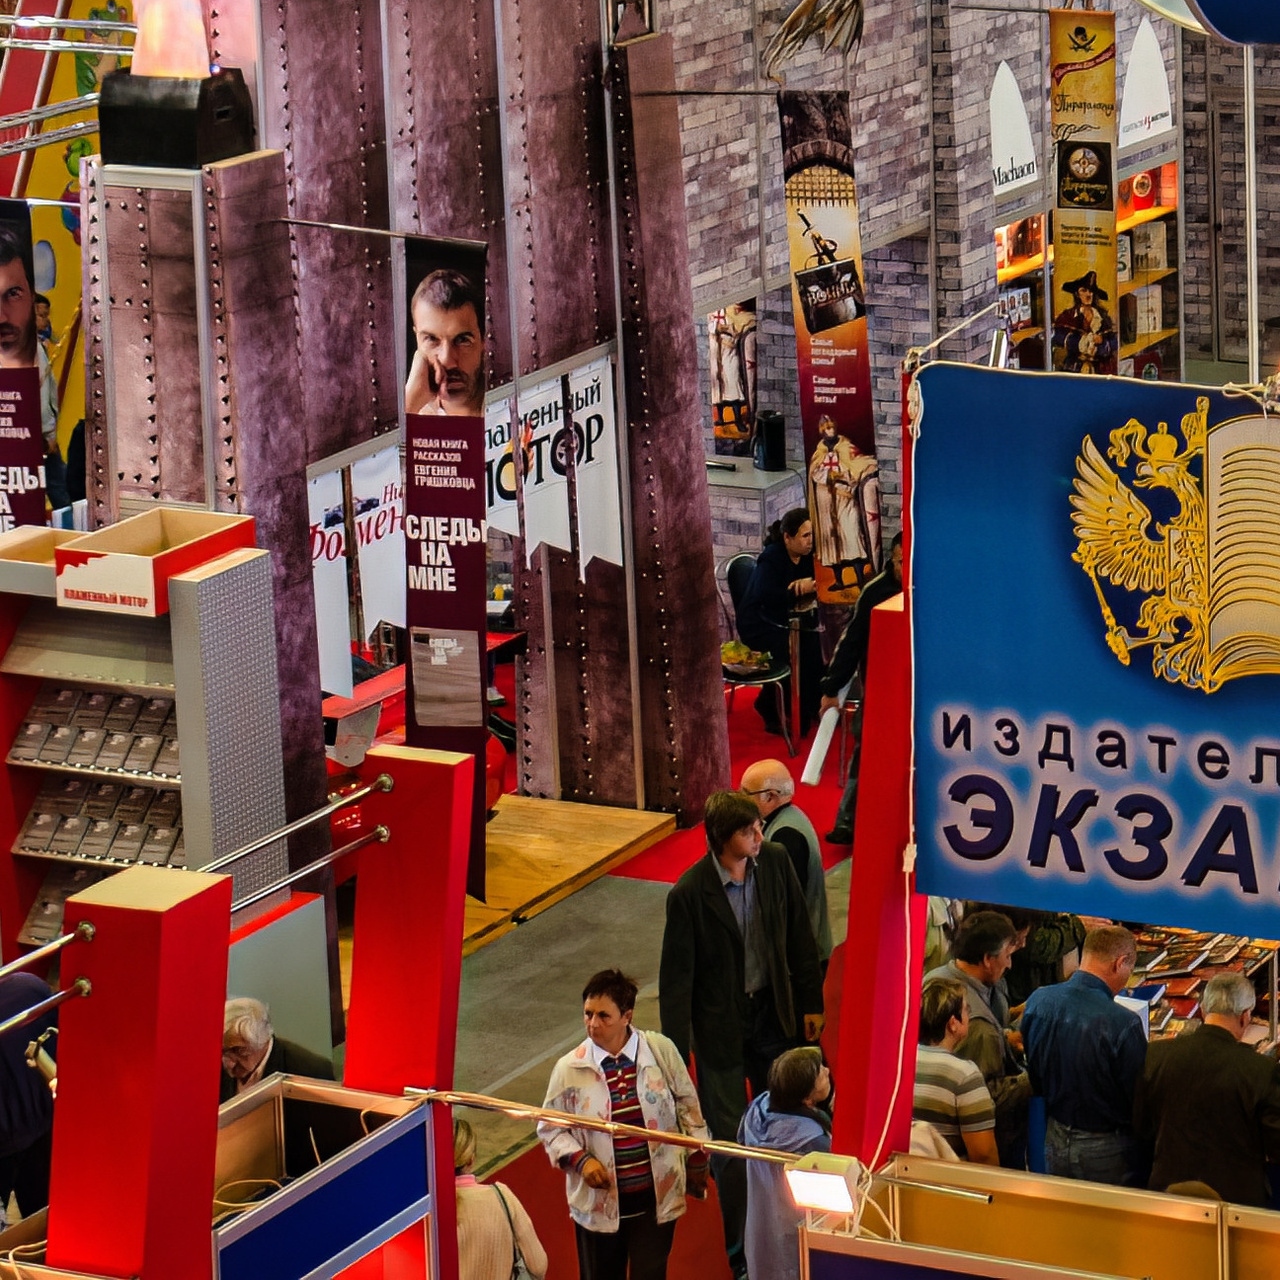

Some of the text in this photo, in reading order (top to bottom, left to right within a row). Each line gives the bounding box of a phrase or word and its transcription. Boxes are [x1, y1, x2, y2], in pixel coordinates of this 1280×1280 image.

[413, 451, 462, 463] РАССКАЗОВ
[0, 466, 46, 495] ЕДЫ
[414, 464, 458, 477] ЕВГЕНИЯ
[415, 476, 476, 491] ГРИШКОВЦА
[406, 514, 488, 547] СЛЕДЫ
[421, 541, 452, 566] НА
[408, 565, 457, 592] МНЕ
